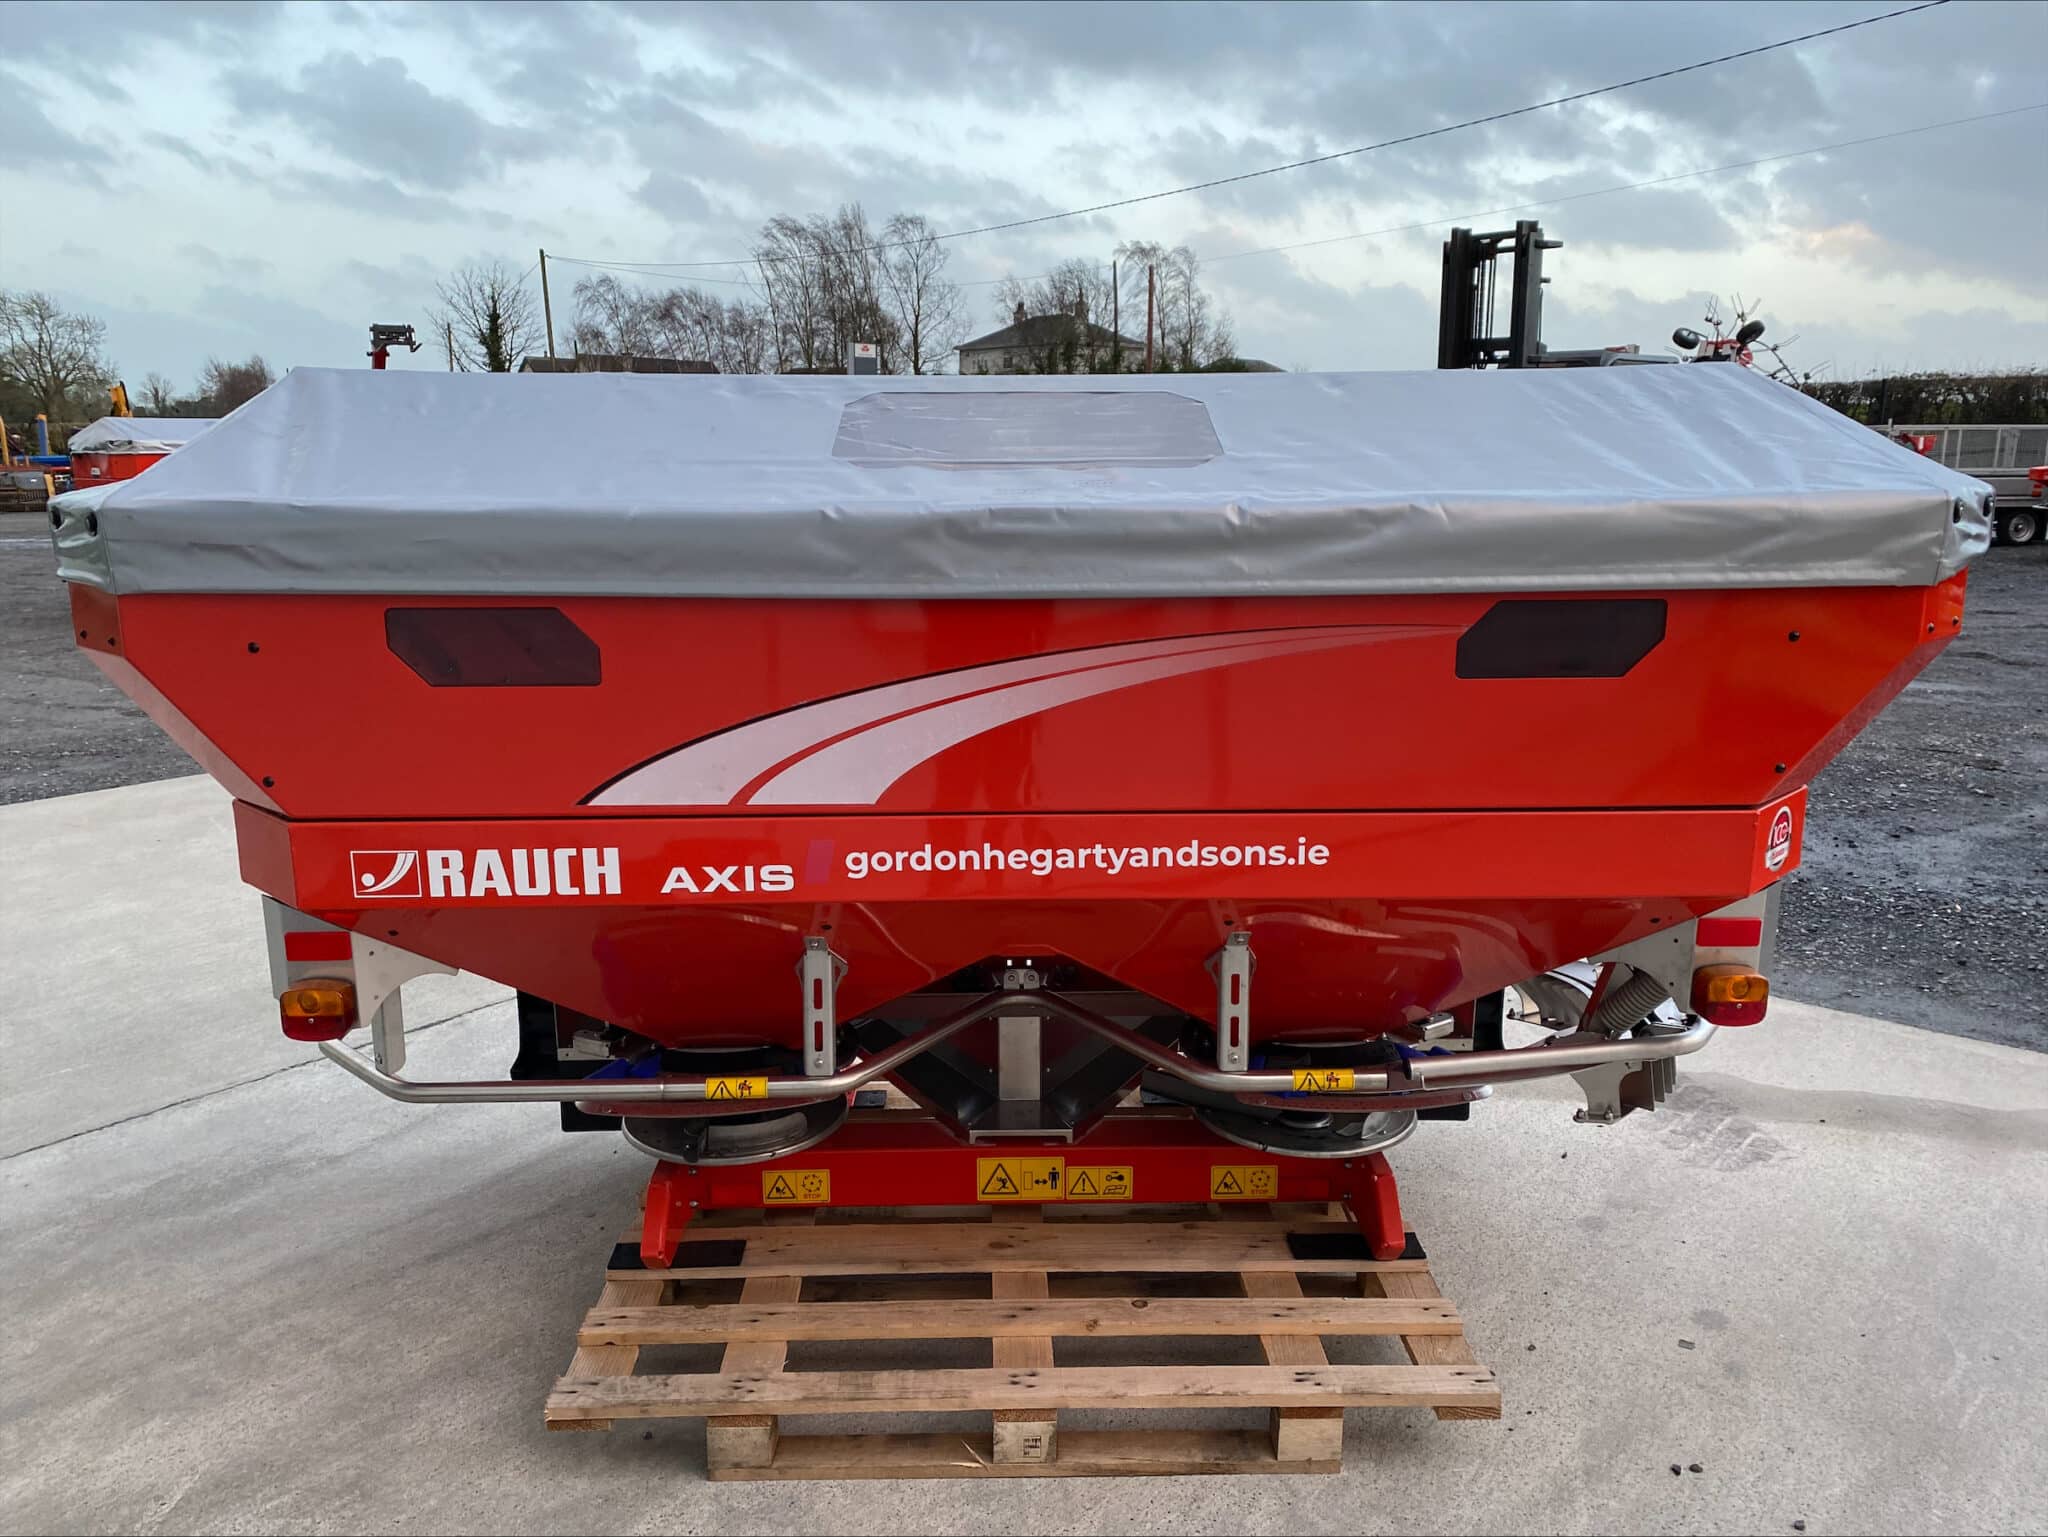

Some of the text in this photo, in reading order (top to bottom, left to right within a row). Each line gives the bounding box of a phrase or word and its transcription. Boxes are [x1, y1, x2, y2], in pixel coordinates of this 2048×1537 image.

[426, 847, 621, 898] RAUCH
[845, 837, 1330, 879] gordonhegartyandsons.ie
[660, 865, 795, 894] AXIS
